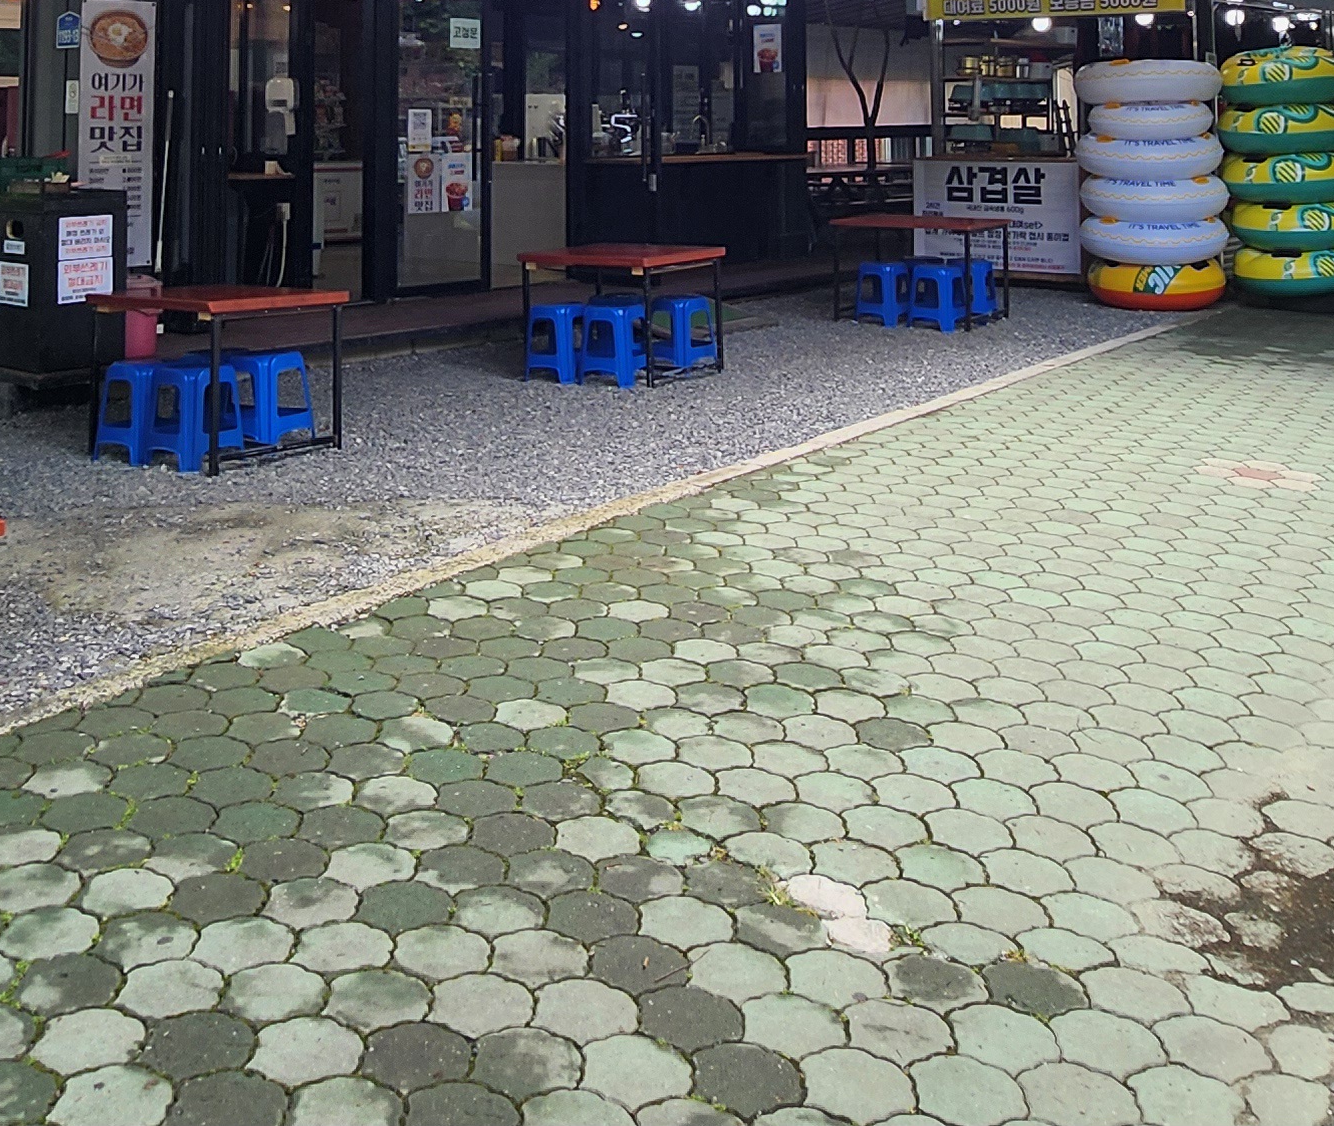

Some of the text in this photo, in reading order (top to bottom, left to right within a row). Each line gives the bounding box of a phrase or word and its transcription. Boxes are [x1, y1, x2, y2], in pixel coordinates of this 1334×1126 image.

[91, 72, 145, 92] 여기가
[89, 94, 144, 122] 라면
[89, 125, 143, 153] 맛집
[1142, 139, 1177, 147] TRAVEL
[945, 165, 1046, 205] 삼겹살
[1117, 179, 1152, 187] TRAVEL
